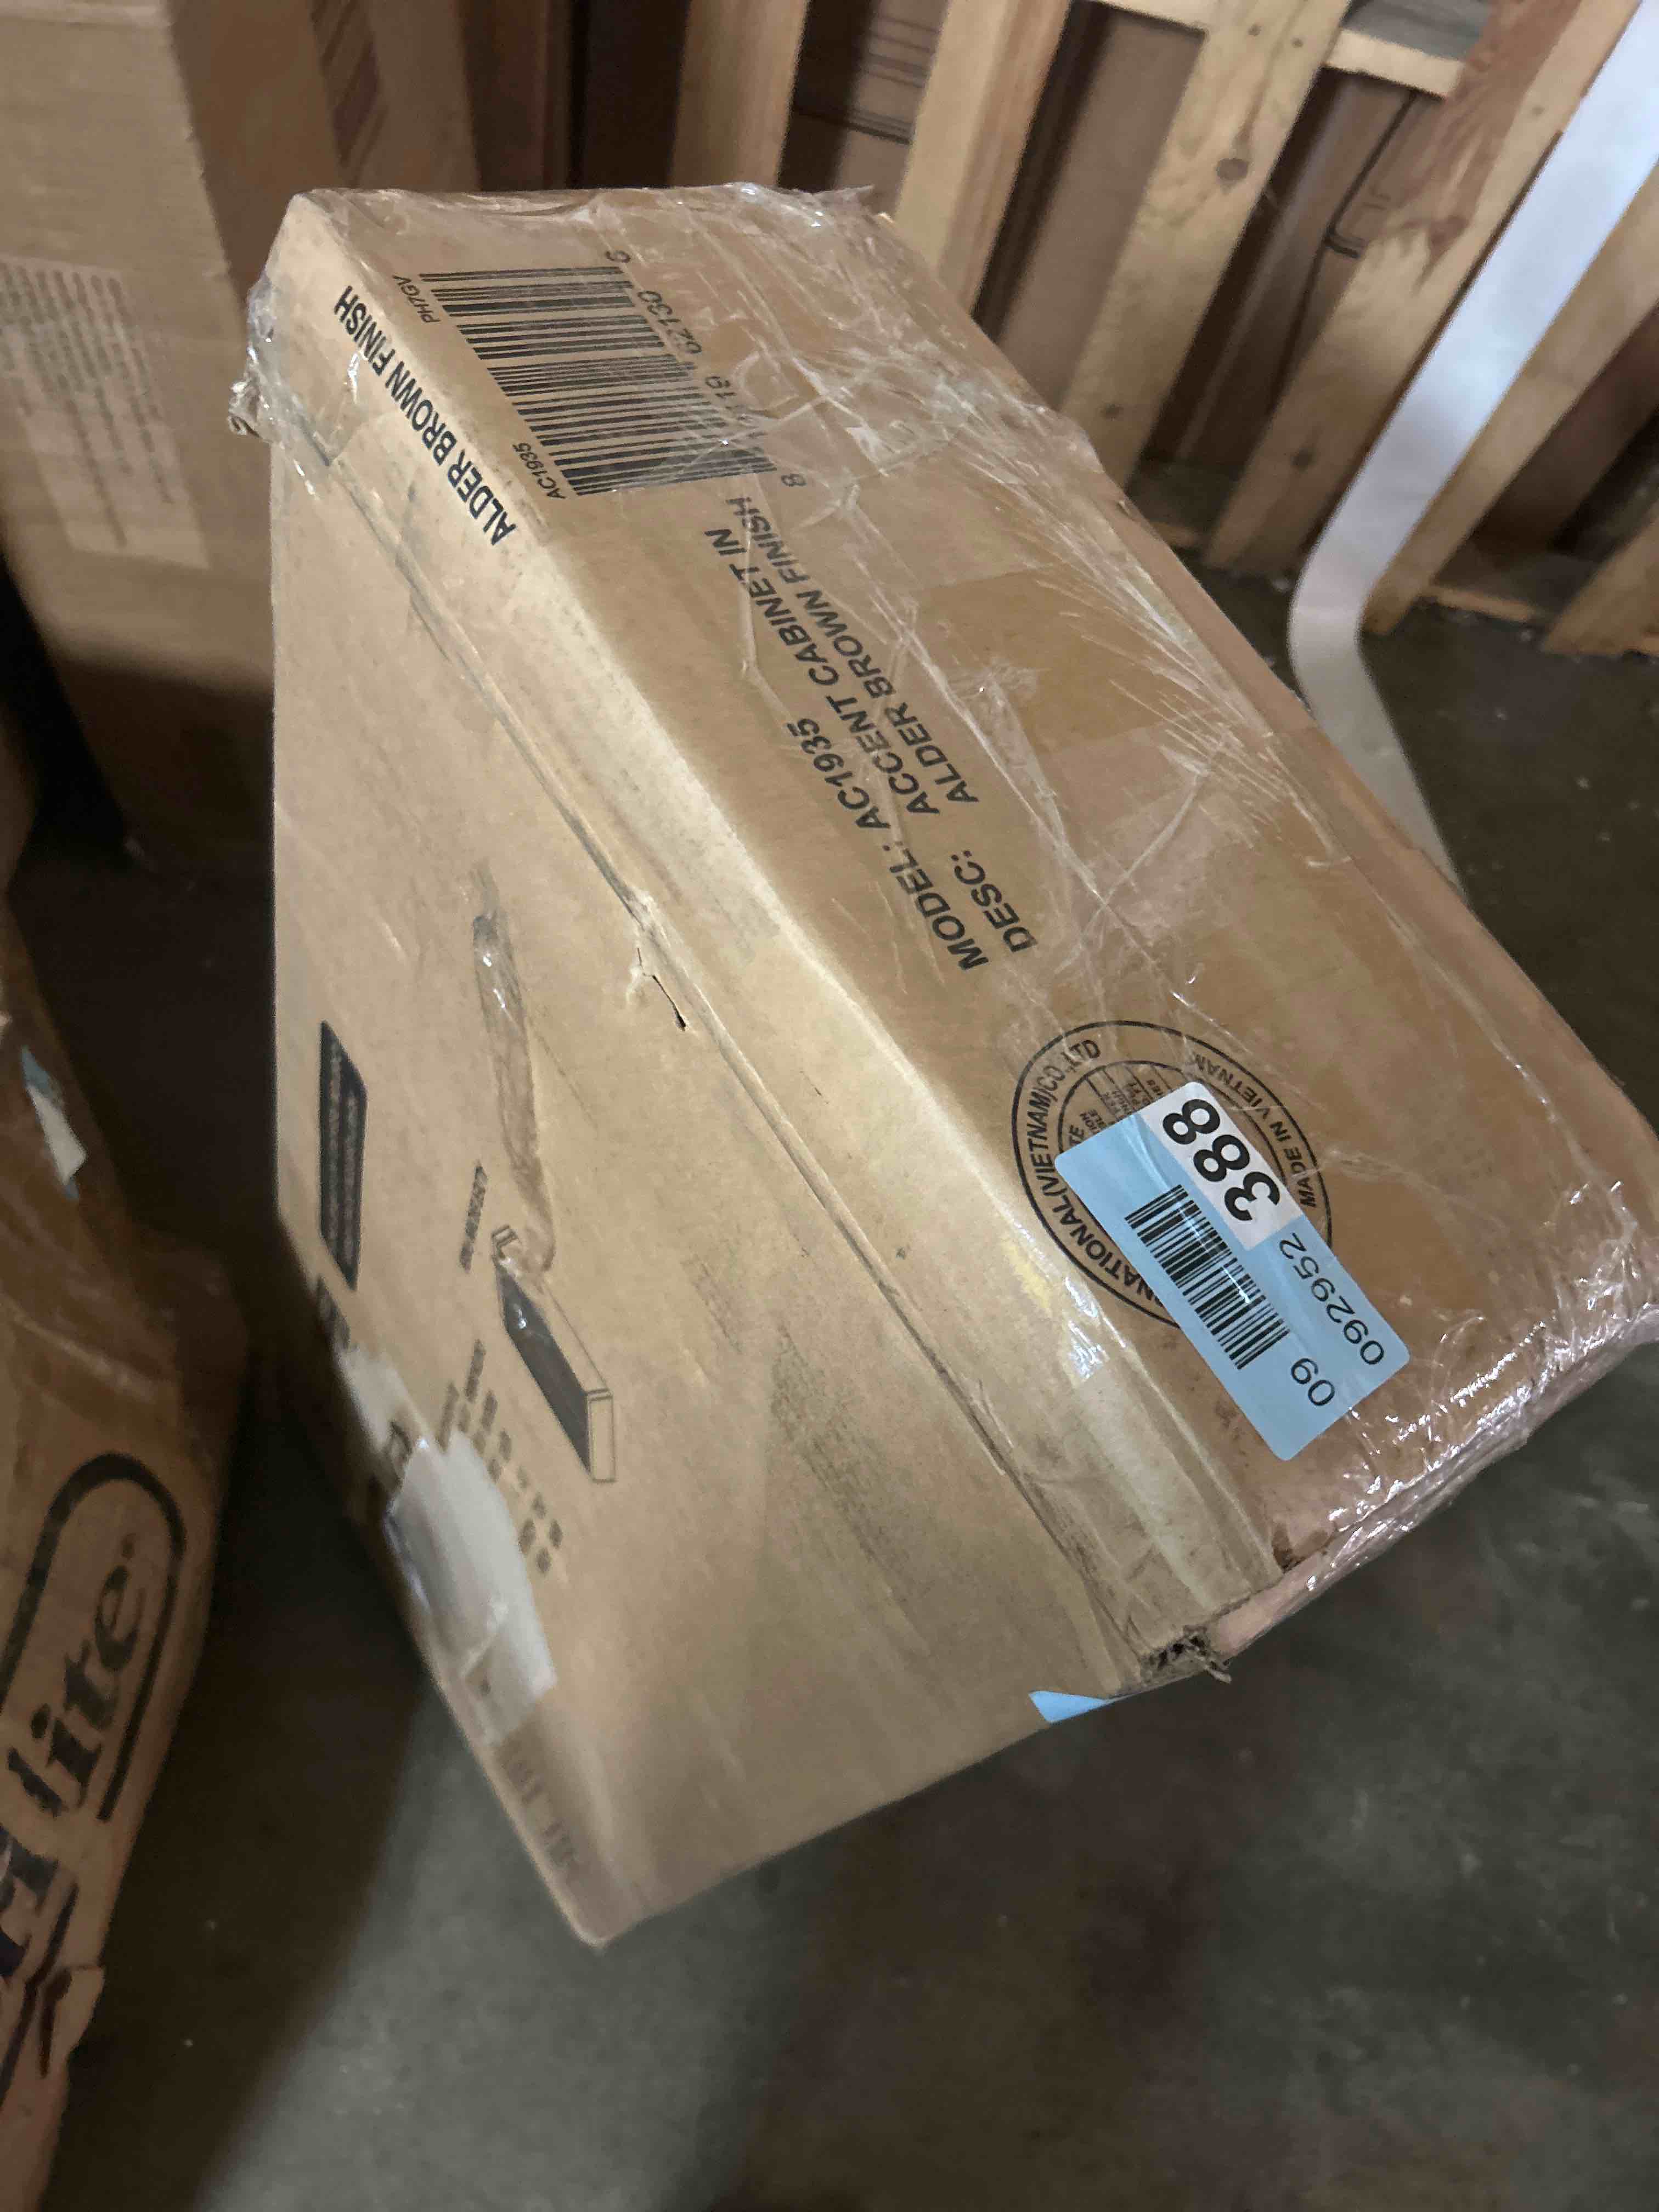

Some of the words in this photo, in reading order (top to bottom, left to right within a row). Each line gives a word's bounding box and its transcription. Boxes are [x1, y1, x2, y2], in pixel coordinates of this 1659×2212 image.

[334, 285, 396, 376] FINISH
[392, 274, 441, 324] PH7GV
[385, 360, 458, 466] BROWN
[448, 449, 516, 546] ALDER
[511, 442, 566, 501] AC1935
[781, 473, 806, 487] 8
[704, 529, 747, 556] IN
[726, 496, 810, 584] FINISH
[729, 564, 839, 685] CABINET
[795, 590, 896, 698] BROWN
[787, 718, 891, 830] AC1935
[826, 695, 940, 814] ACCENT
[884, 702, 979, 803] ALDER
[883, 840, 989, 970] MODEL:
[951, 850, 1038, 952] DESC:
[1194, 1053, 1272, 1120] VIETNAM
[1269, 1121, 1291, 1142] IN
[1161, 1098, 1281, 1222] 388
[1283, 1146, 1318, 1208] MADE
[1279, 1233, 1385, 1365] 092952
[1291, 1358, 1335, 1407] 09
